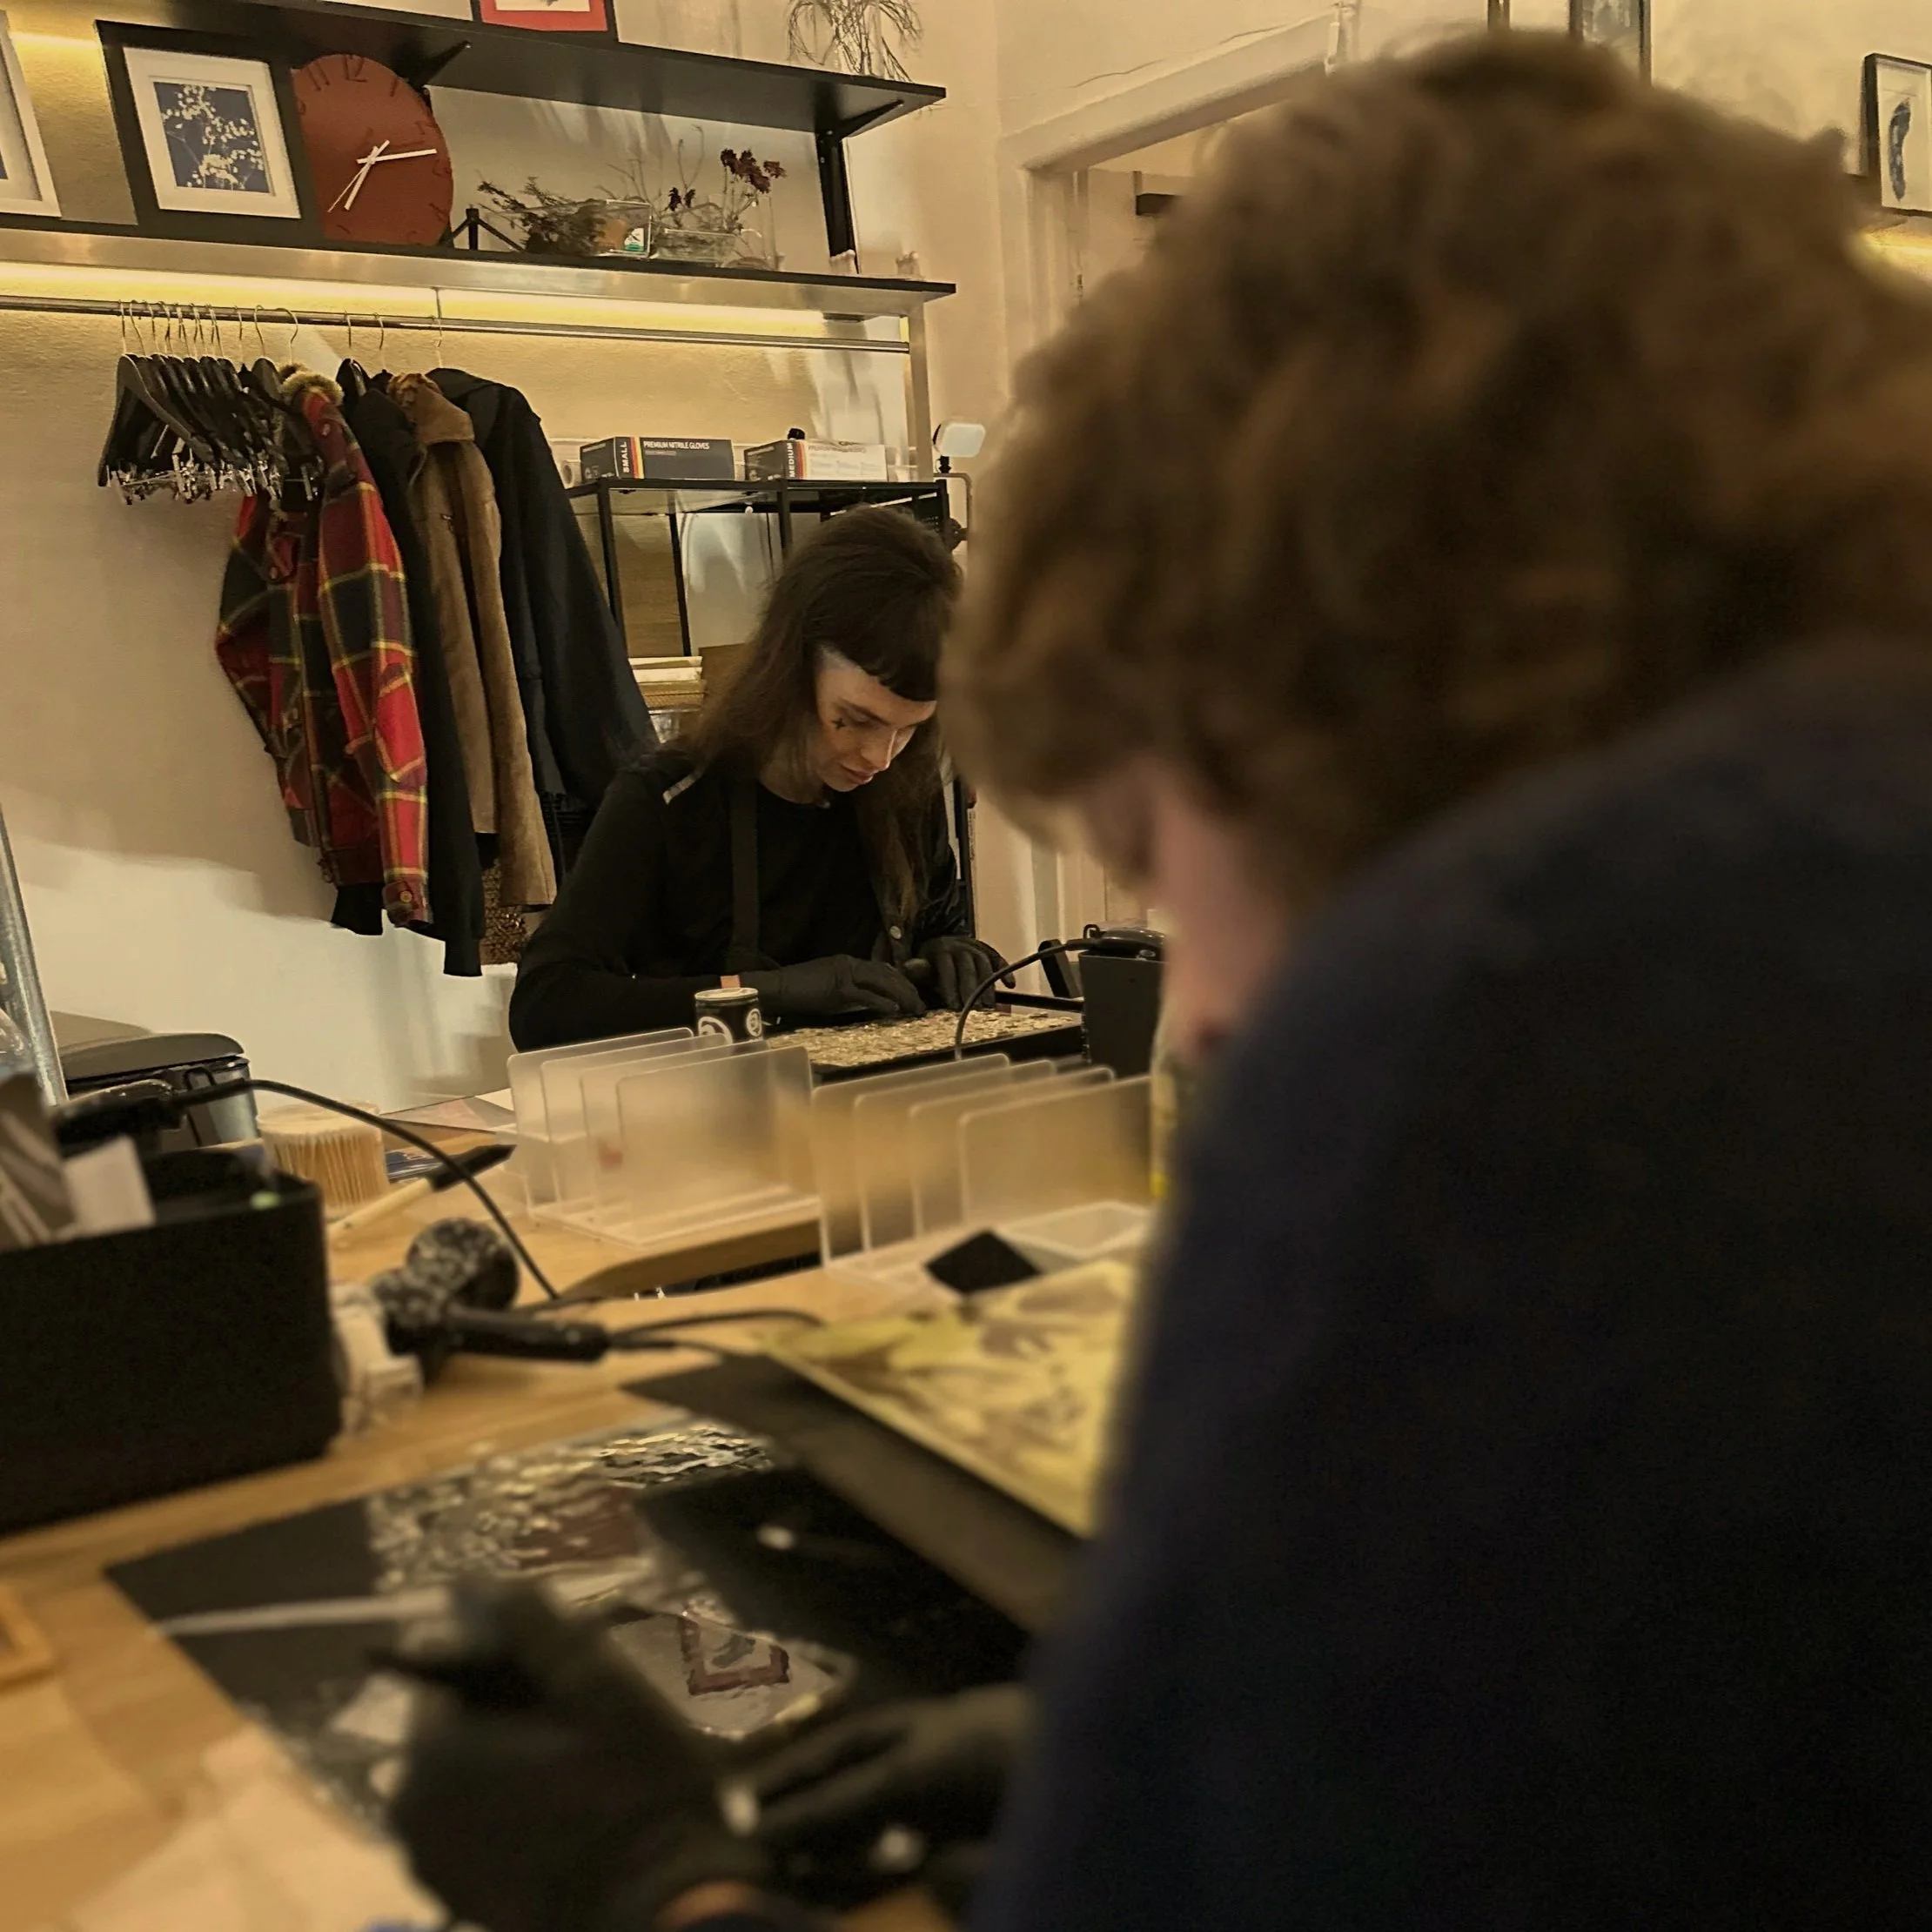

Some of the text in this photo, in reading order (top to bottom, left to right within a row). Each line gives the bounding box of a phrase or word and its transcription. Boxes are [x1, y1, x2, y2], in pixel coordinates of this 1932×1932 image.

[620, 441, 630, 473] SMALL
[643, 440, 669, 449] PREMIUM
[787, 442, 795, 478] MEDIUM
